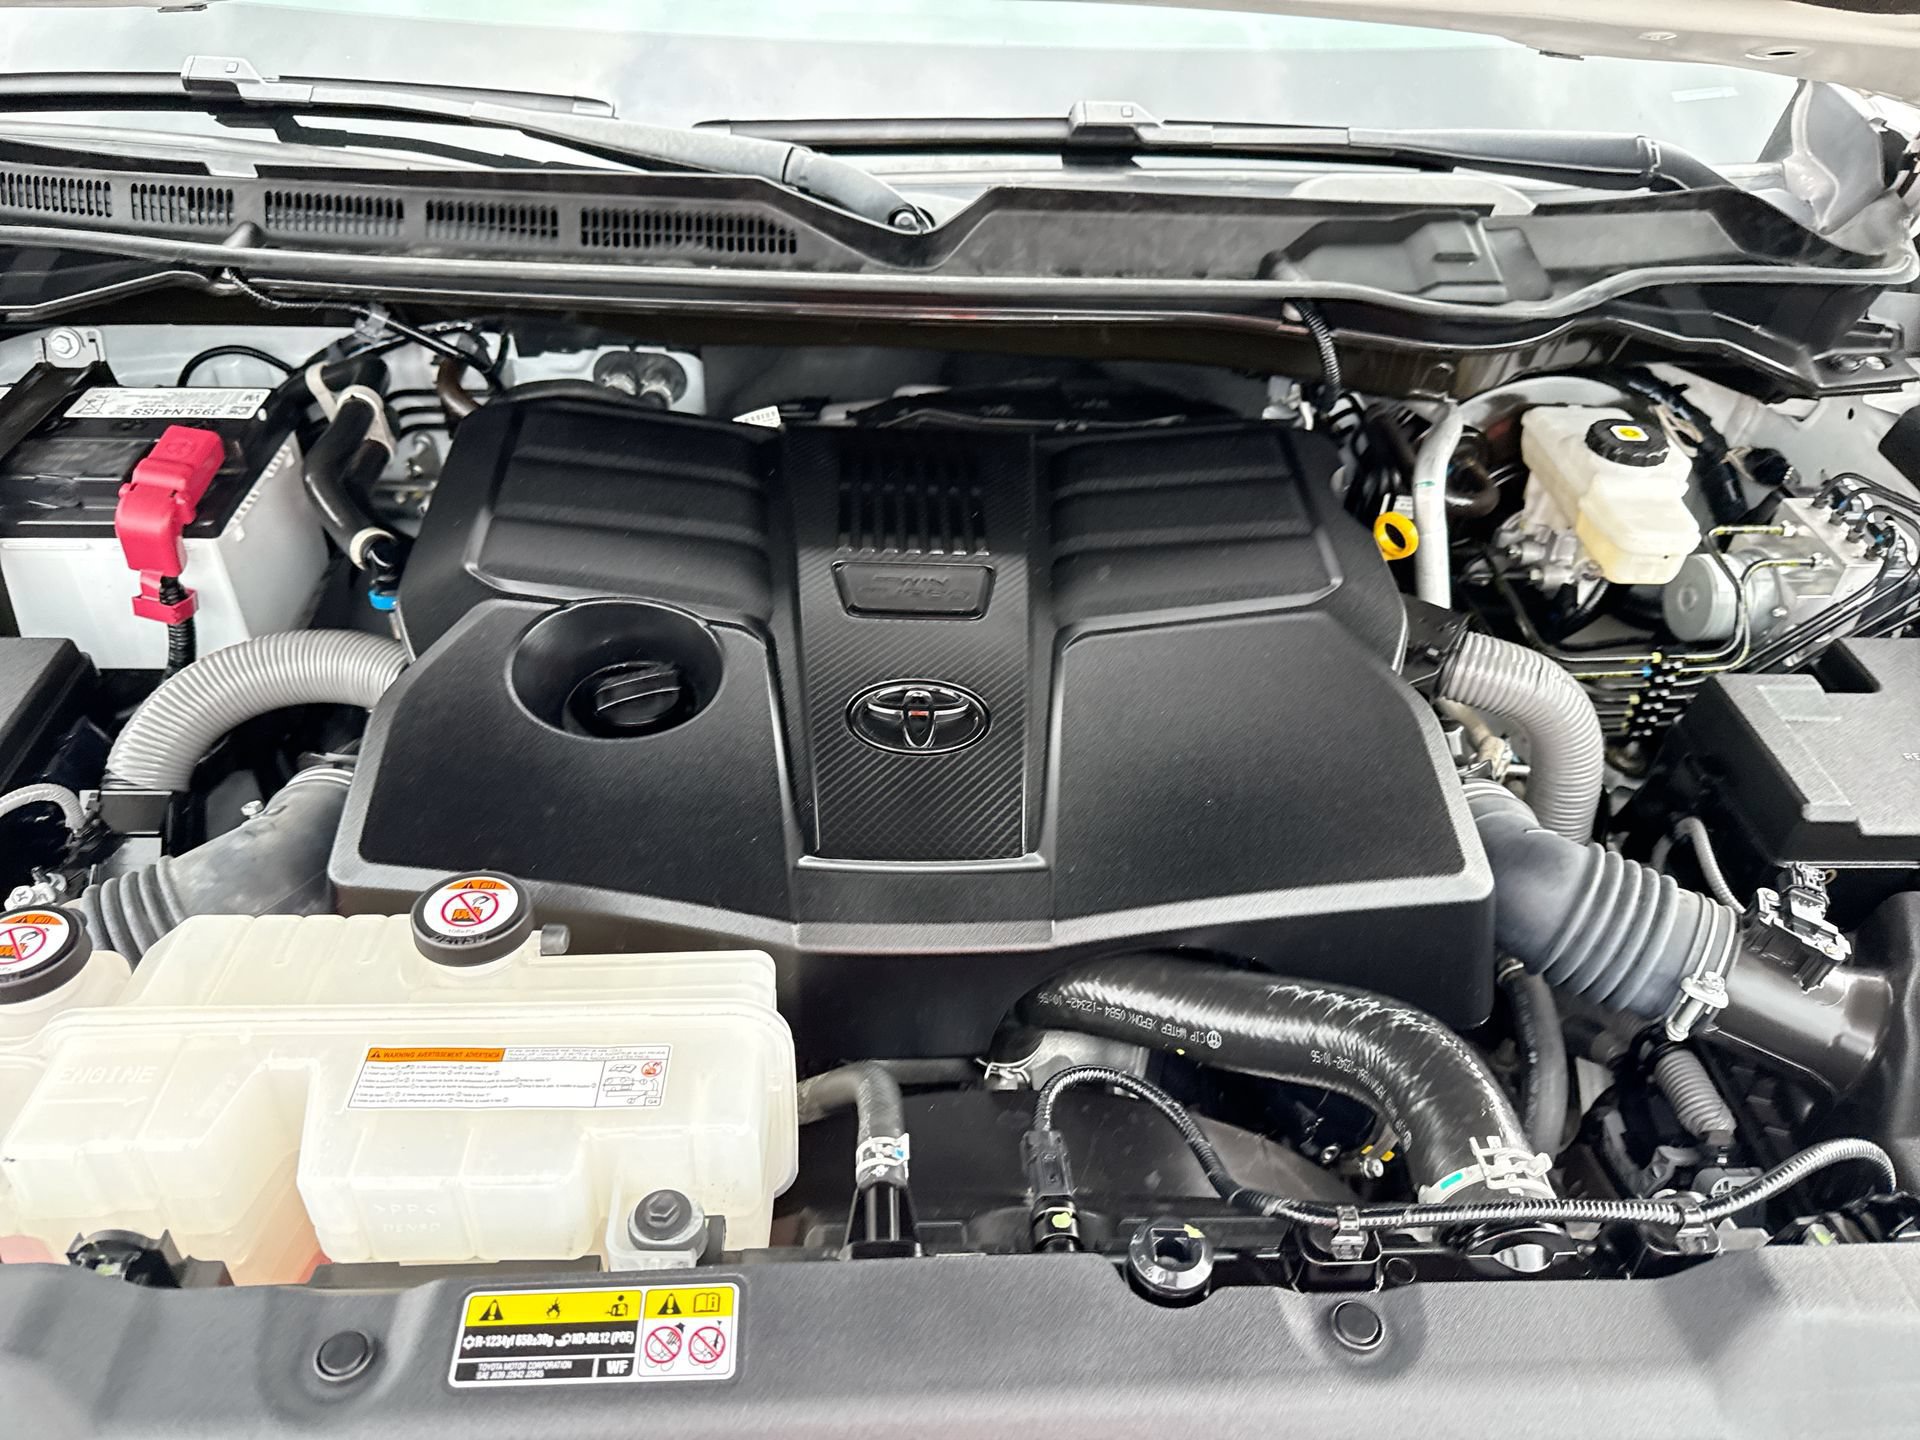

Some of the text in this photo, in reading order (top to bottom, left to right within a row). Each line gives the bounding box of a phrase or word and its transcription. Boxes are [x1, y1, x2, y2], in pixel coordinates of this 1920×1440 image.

[58, 1065, 159, 1084] ENGINE
[478, 1360, 573, 1371] TOYOTA MOTOR CORPORATION
[606, 1360, 629, 1375] WF
